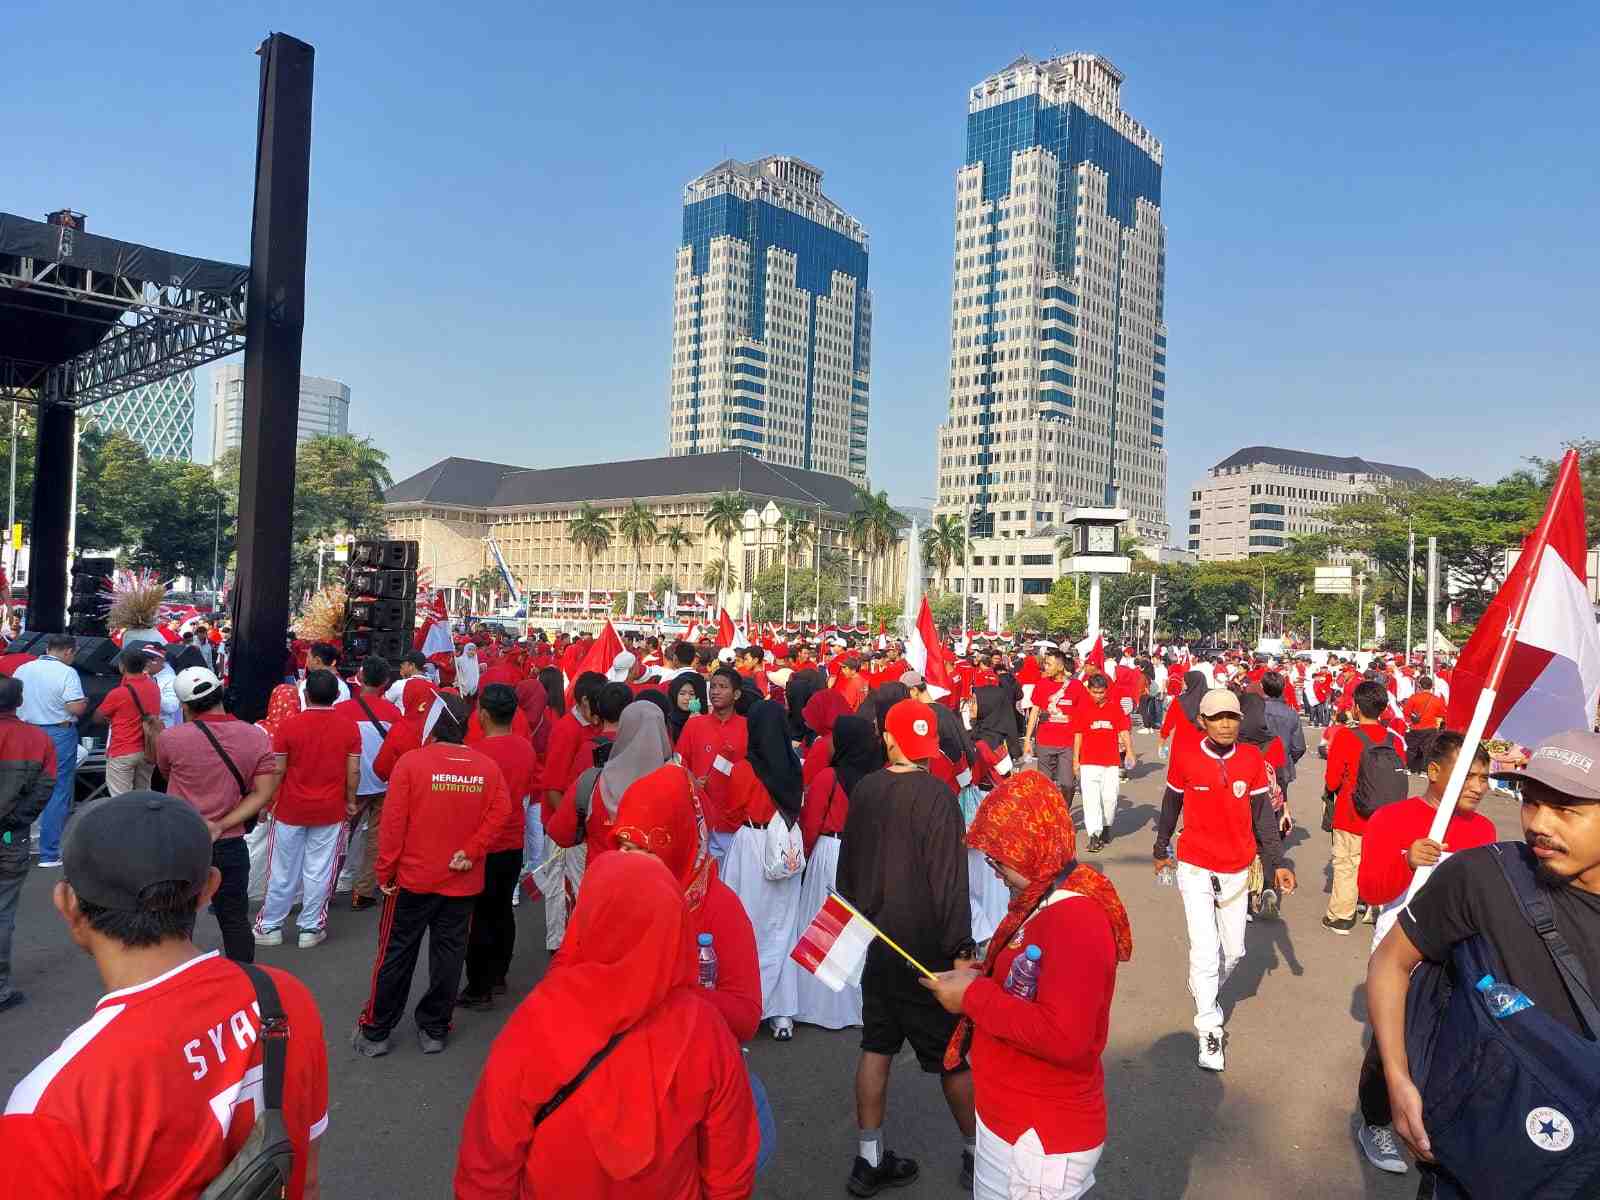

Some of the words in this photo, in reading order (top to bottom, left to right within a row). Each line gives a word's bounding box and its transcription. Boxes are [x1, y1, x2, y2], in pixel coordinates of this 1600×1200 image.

[432, 774, 484, 784] HERBALIFE
[432, 783, 483, 793] NUTRITION
[183, 1000, 262, 1081] SYA
